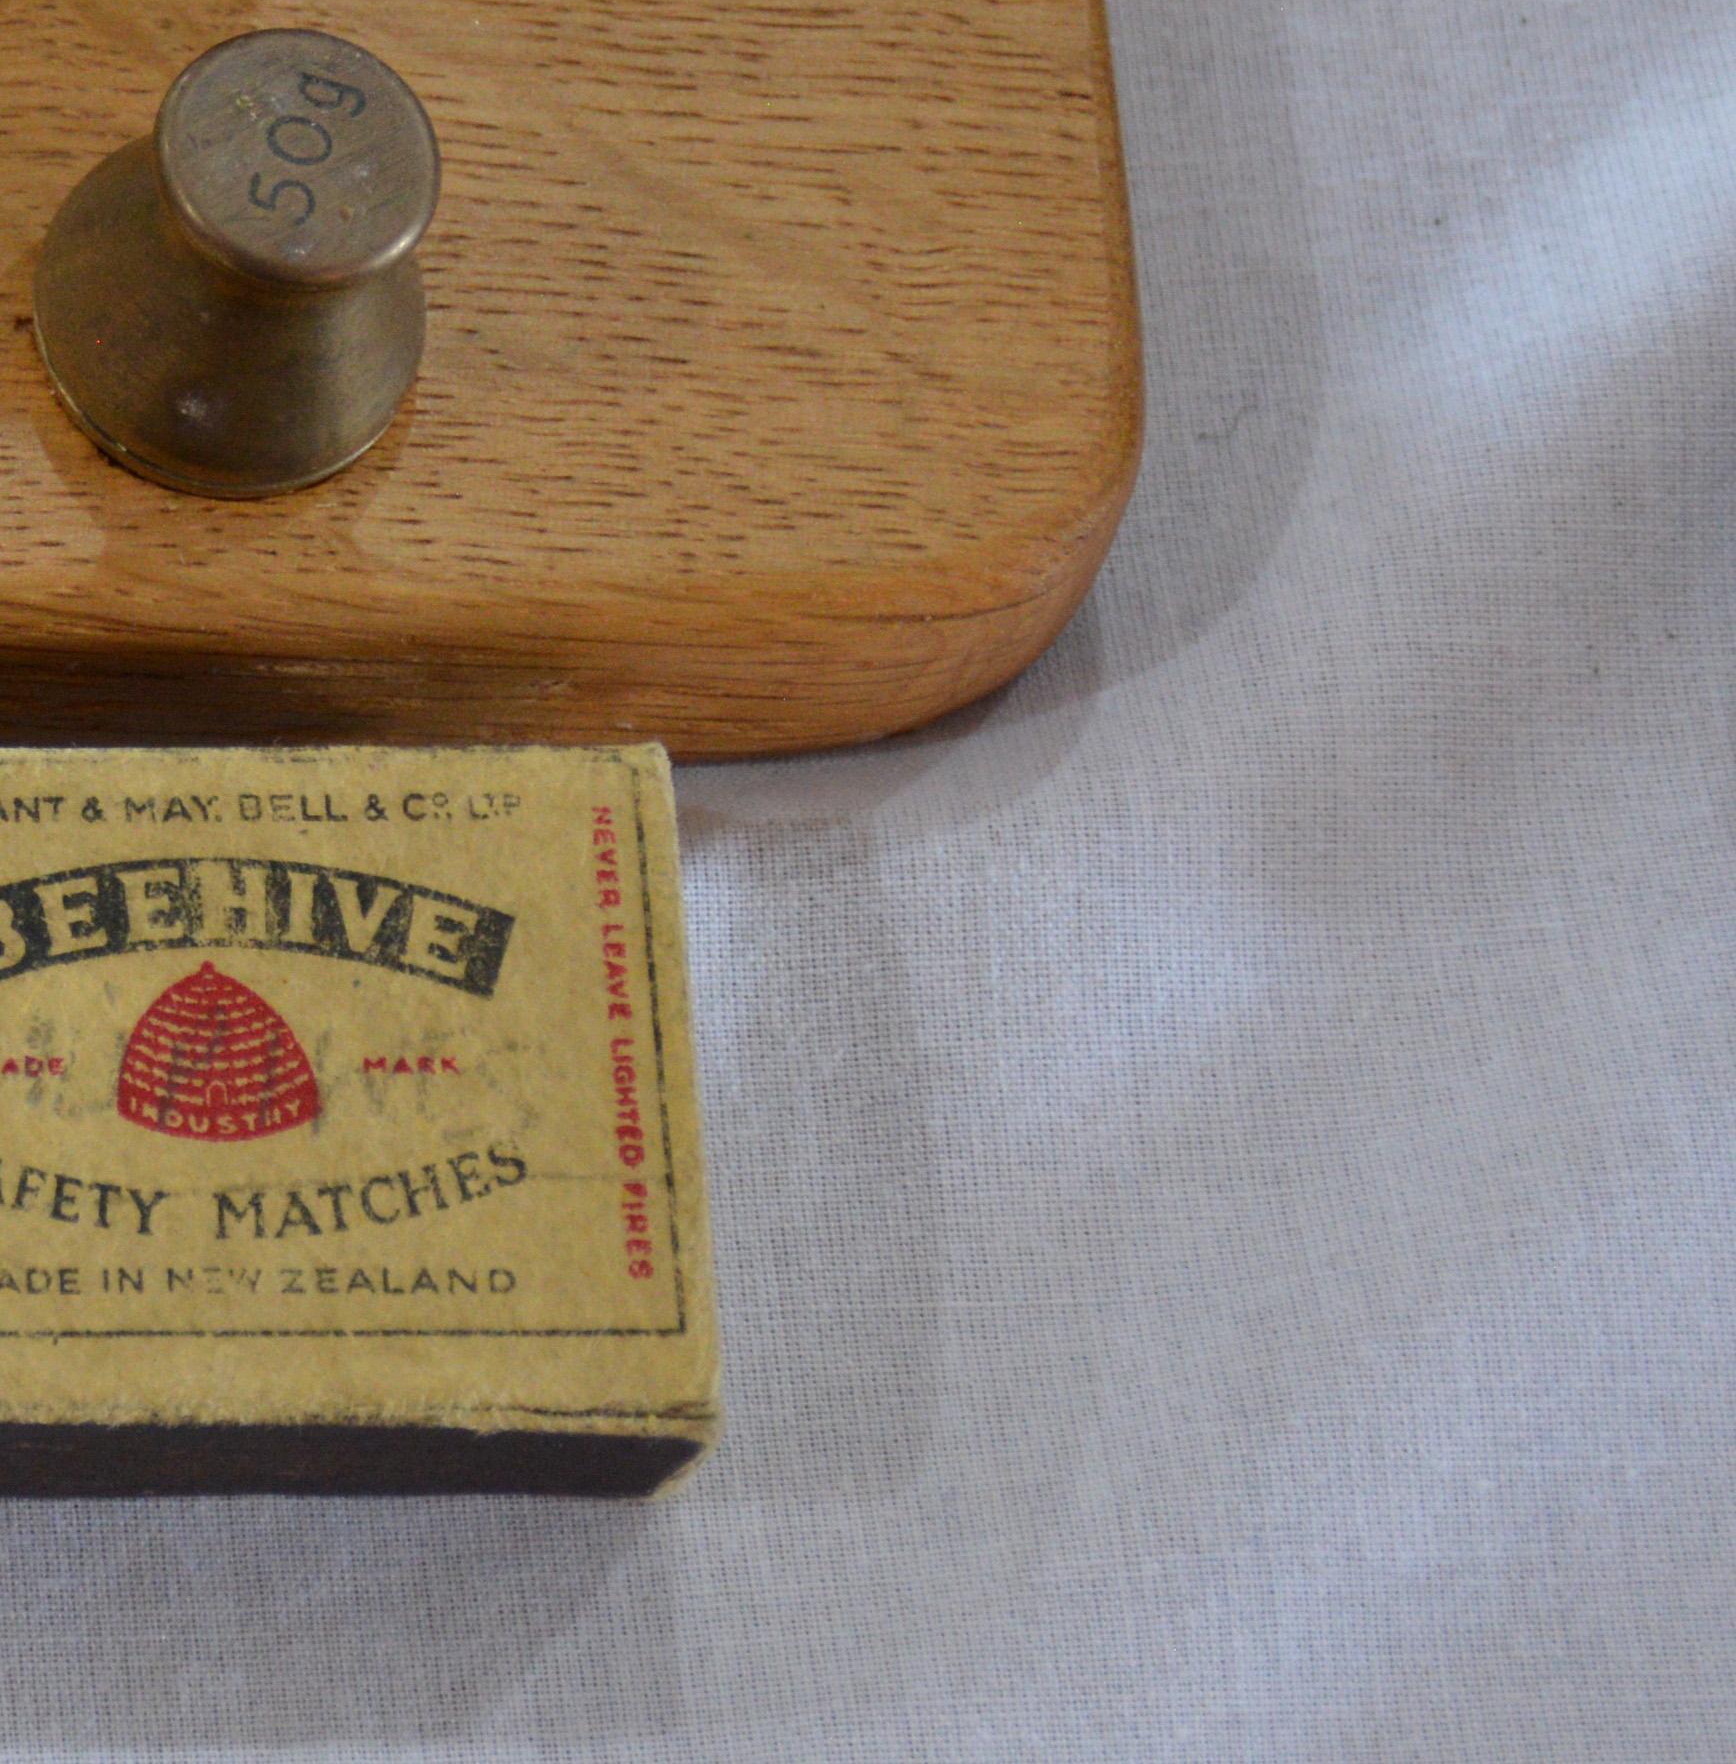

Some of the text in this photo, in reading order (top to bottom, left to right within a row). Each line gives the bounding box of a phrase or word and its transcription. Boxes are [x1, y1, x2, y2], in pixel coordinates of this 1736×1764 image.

[245, 70, 368, 228] 50g
[80, 794, 107, 823] &
[237, 792, 349, 823] BELL
[363, 792, 390, 822] &
[591, 805, 656, 1281] NEVER LEAVE LIGHTED FIRES
[362, 1055, 461, 1076] MARK
[129, 1095, 302, 1135] INDUSTRY
[212, 1140, 529, 1240] MATCHES
[102, 1266, 145, 1296] IN
[166, 1266, 265, 1296] NEW
[281, 1266, 518, 1296] ZEALAND
